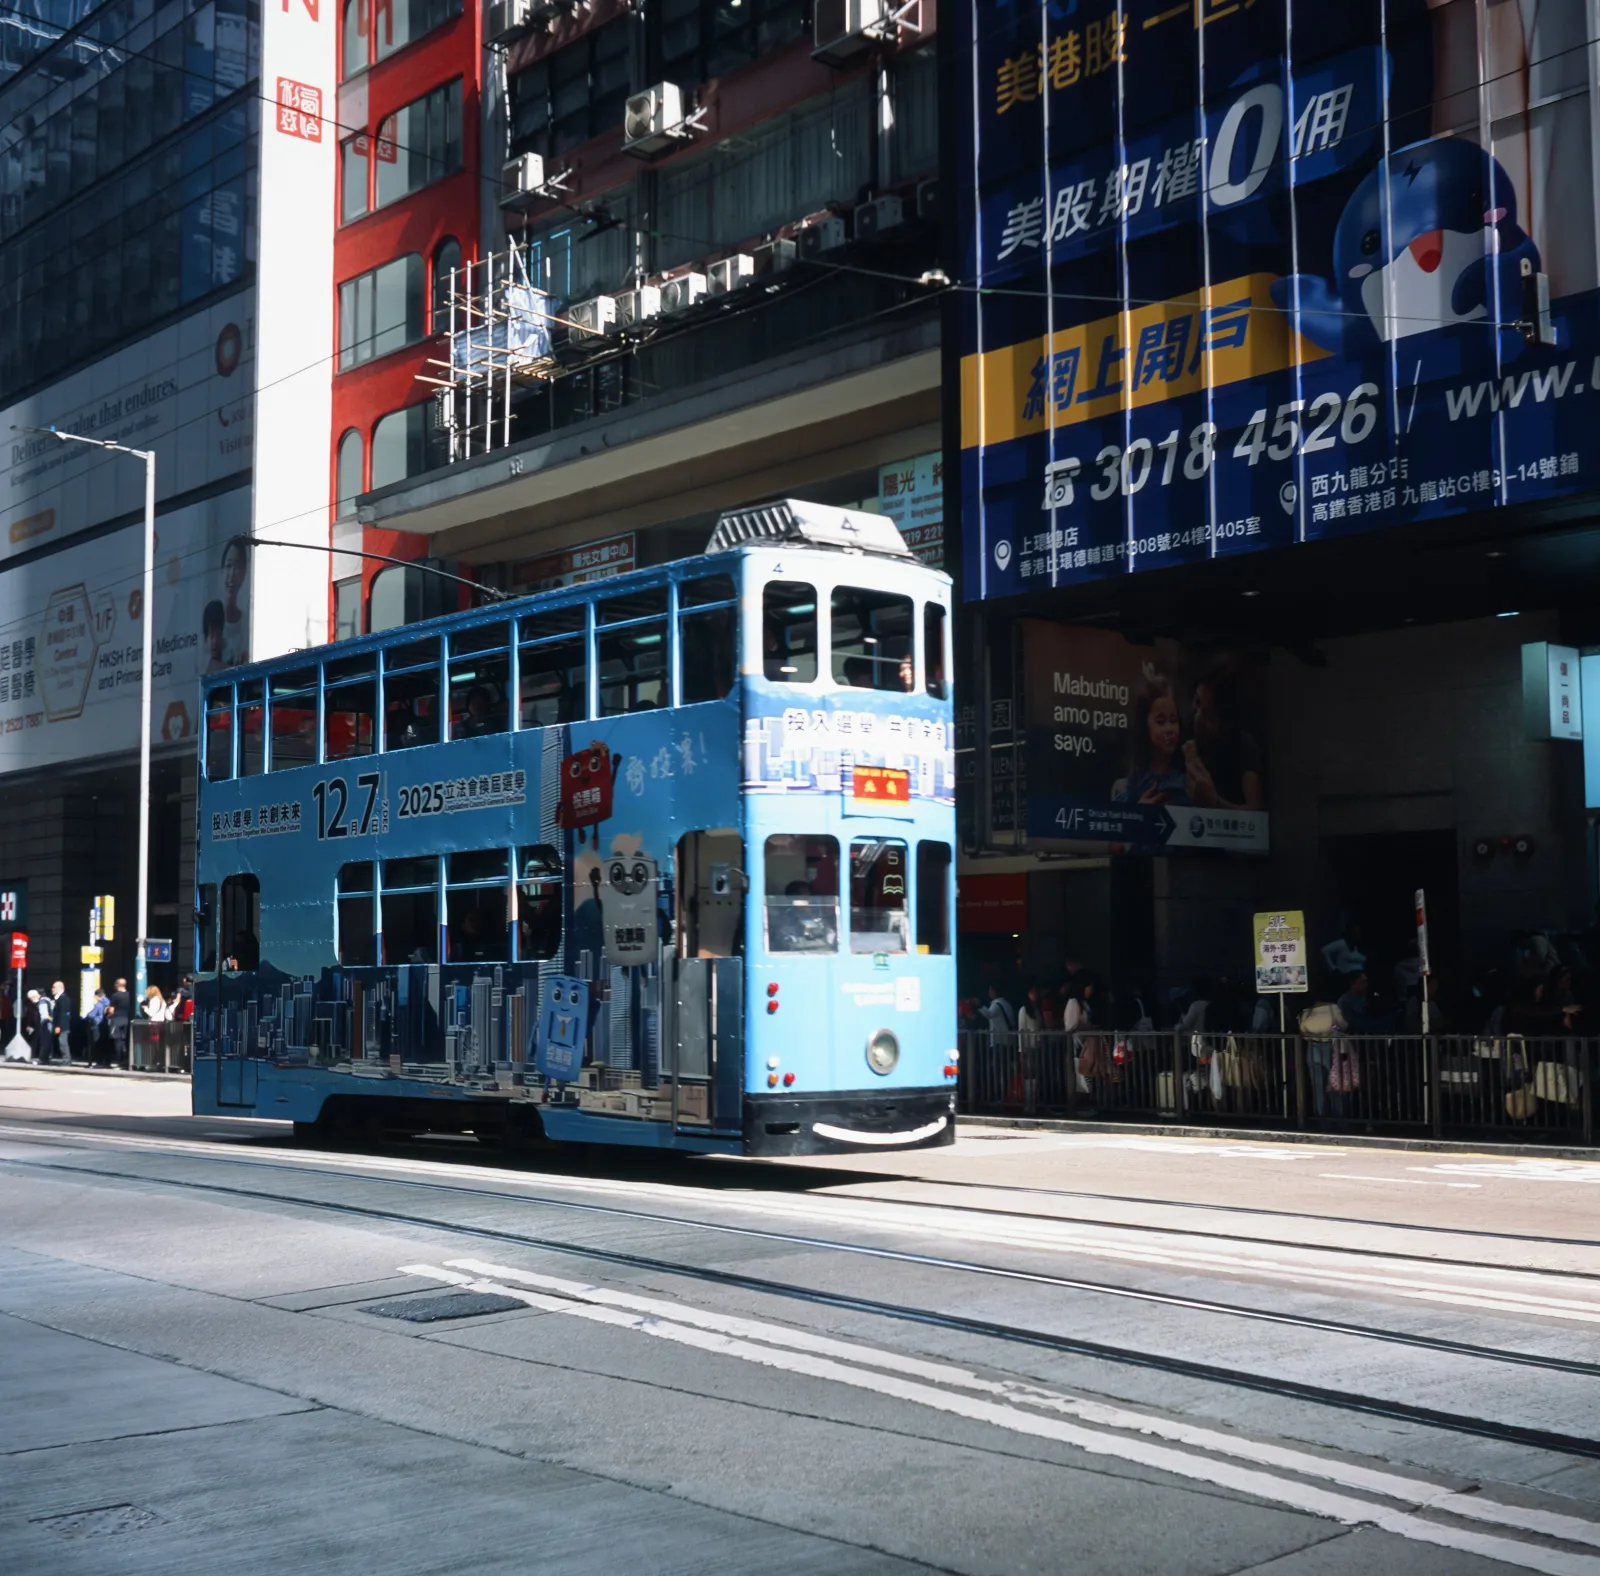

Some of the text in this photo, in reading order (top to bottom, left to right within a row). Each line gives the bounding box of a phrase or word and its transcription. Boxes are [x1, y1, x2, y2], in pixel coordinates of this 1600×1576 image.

[1022, 297, 1251, 420] 網上開戶
[99, 402, 122, 424] that
[1090, 421, 1219, 501] 3018
[1232, 382, 1379, 467] 4526
[1446, 355, 1600, 422] www.
[1311, 457, 1409, 498] 西九龍分店
[96, 608, 112, 633] 1/F
[99, 649, 123, 669] HKSH
[156, 633, 197, 656] Medicine
[98, 660, 172, 690] and Prima Care
[1054, 671, 1129, 705] Mabuting
[1054, 705, 1128, 730] amo para
[1054, 734, 1096, 757] sayo.
[399, 784, 443, 816] 2025
[445, 772, 525, 799] 立法會換屆選舉
[213, 802, 301, 831] 投入選舉 共創未來
[1055, 807, 1084, 831] 4/F
